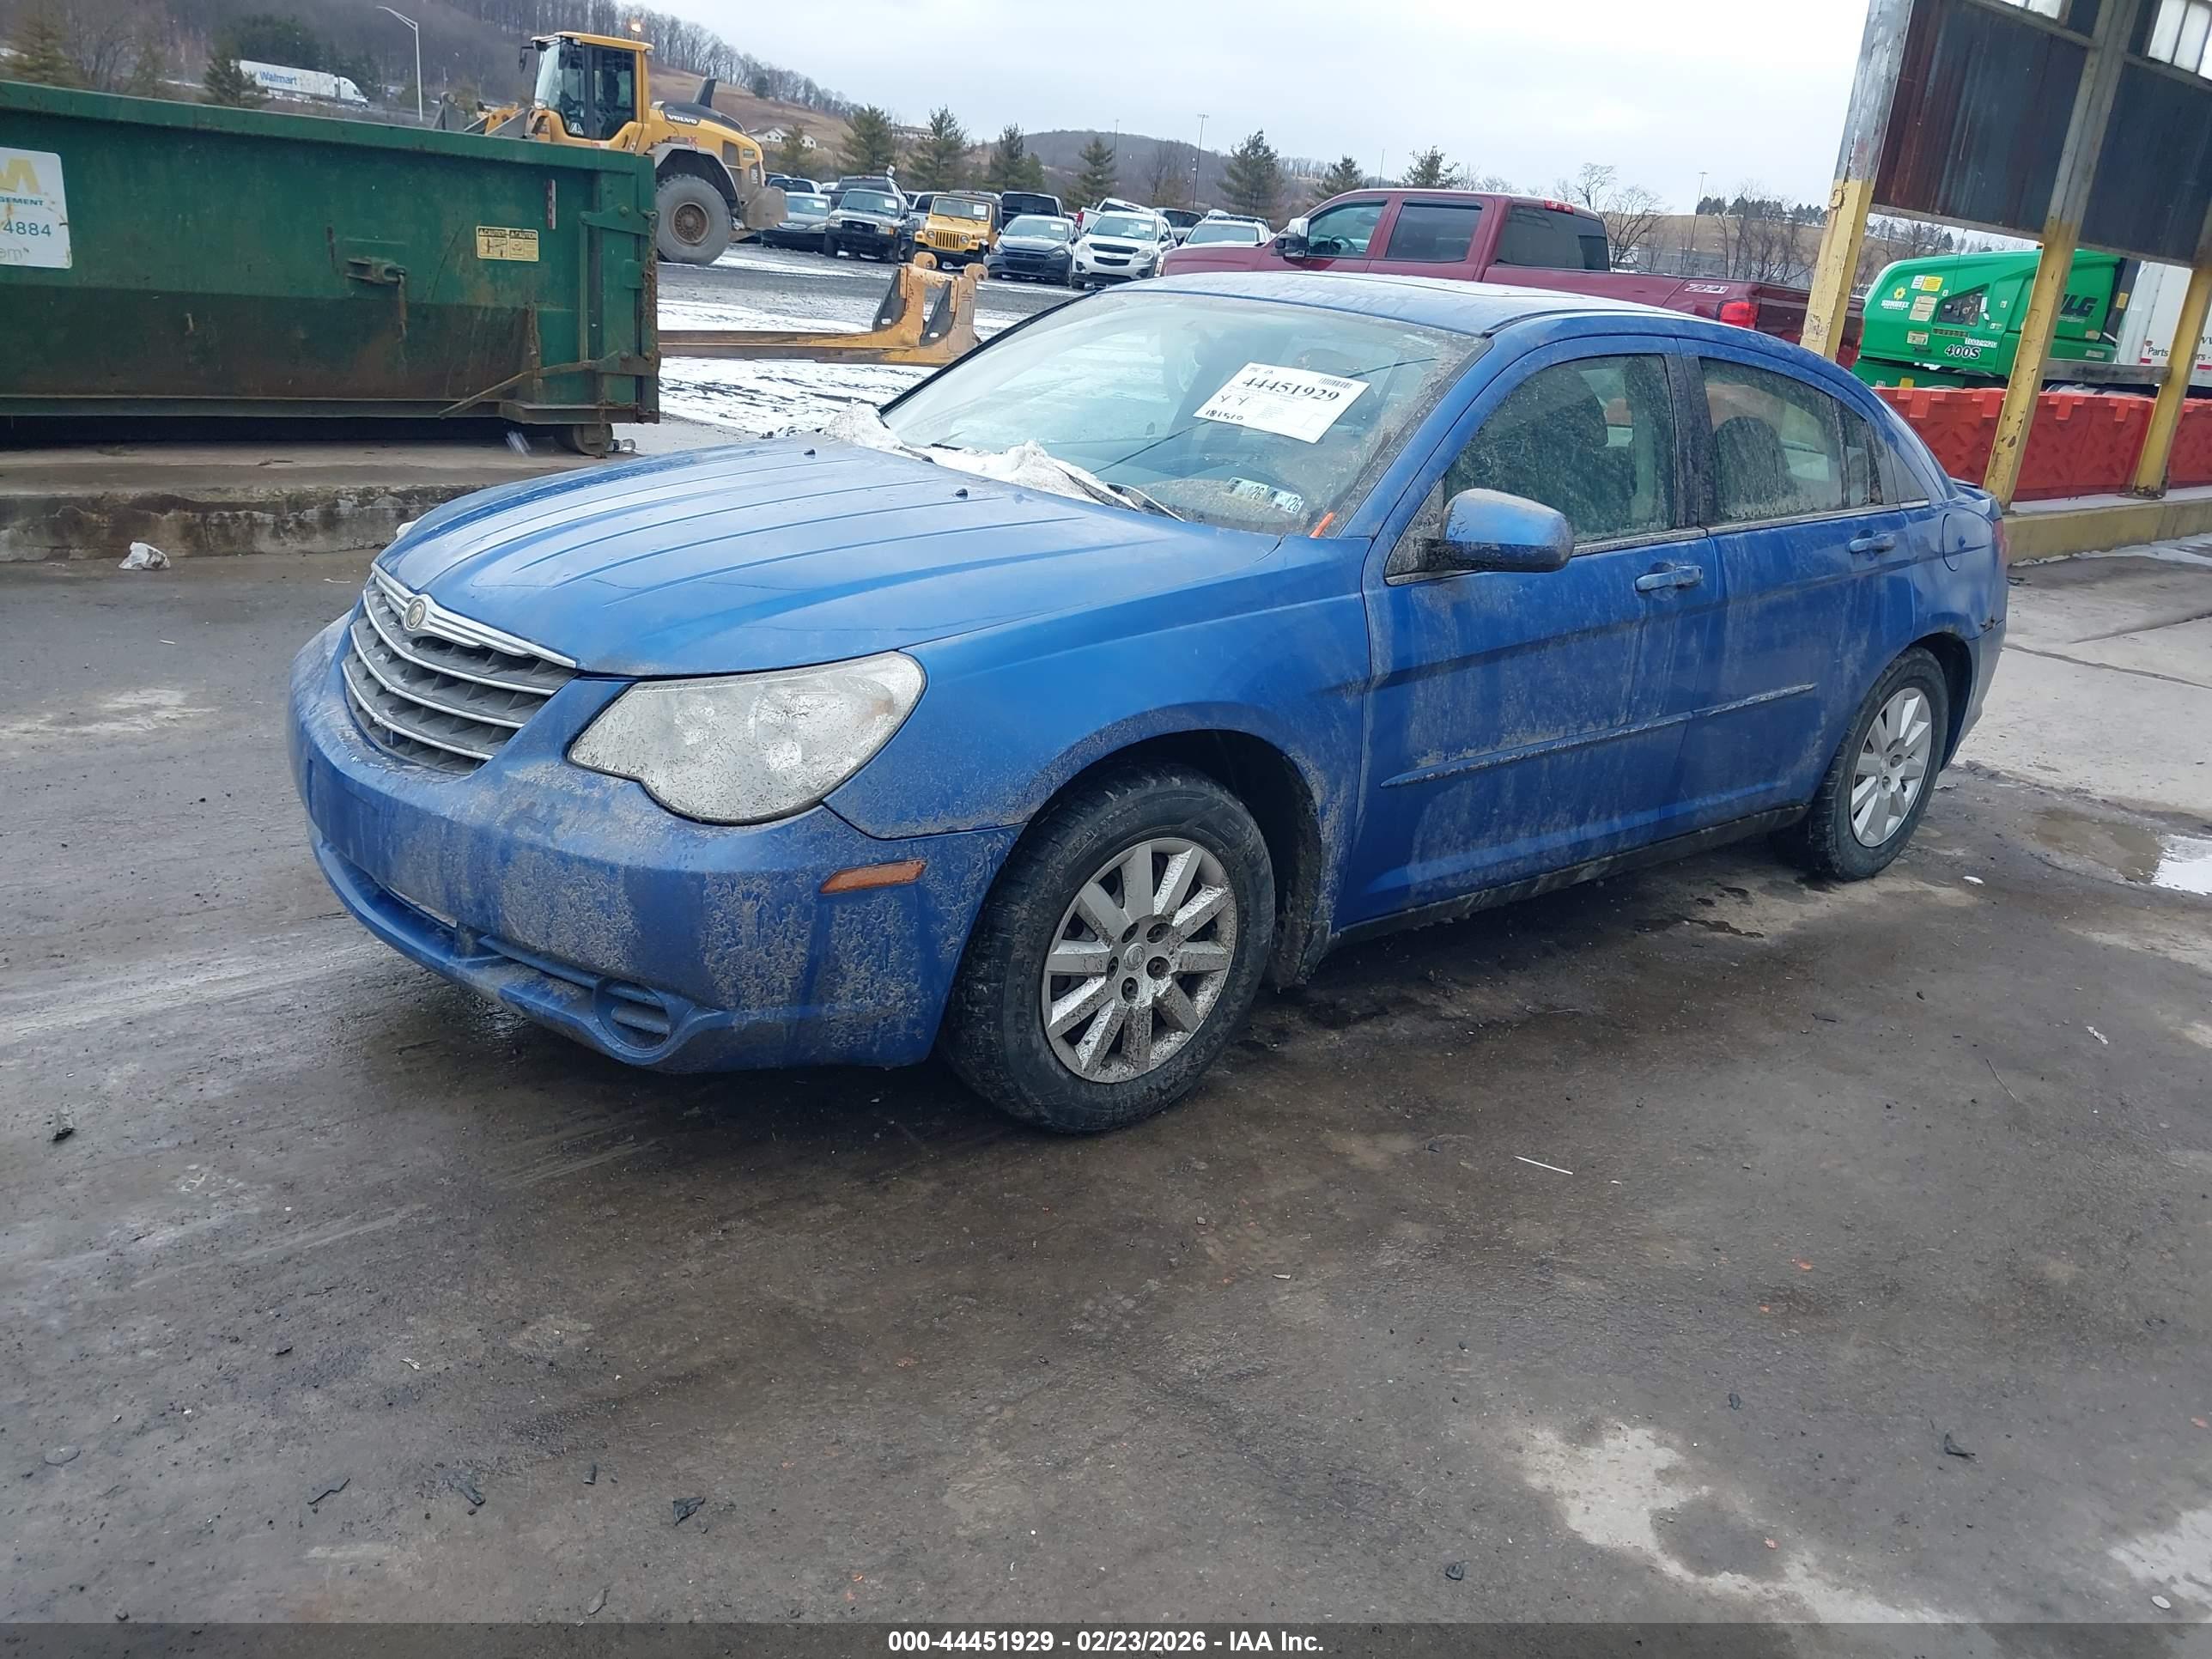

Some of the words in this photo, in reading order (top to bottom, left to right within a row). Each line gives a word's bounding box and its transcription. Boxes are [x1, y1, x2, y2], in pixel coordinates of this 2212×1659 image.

[259, 71, 297, 85] Walmart
[666, 113, 697, 125] VOLVO
[1945, 344, 1981, 359] 400S
[2147, 346, 2169, 357] Parts
[1242, 377, 1340, 403] 44451929
